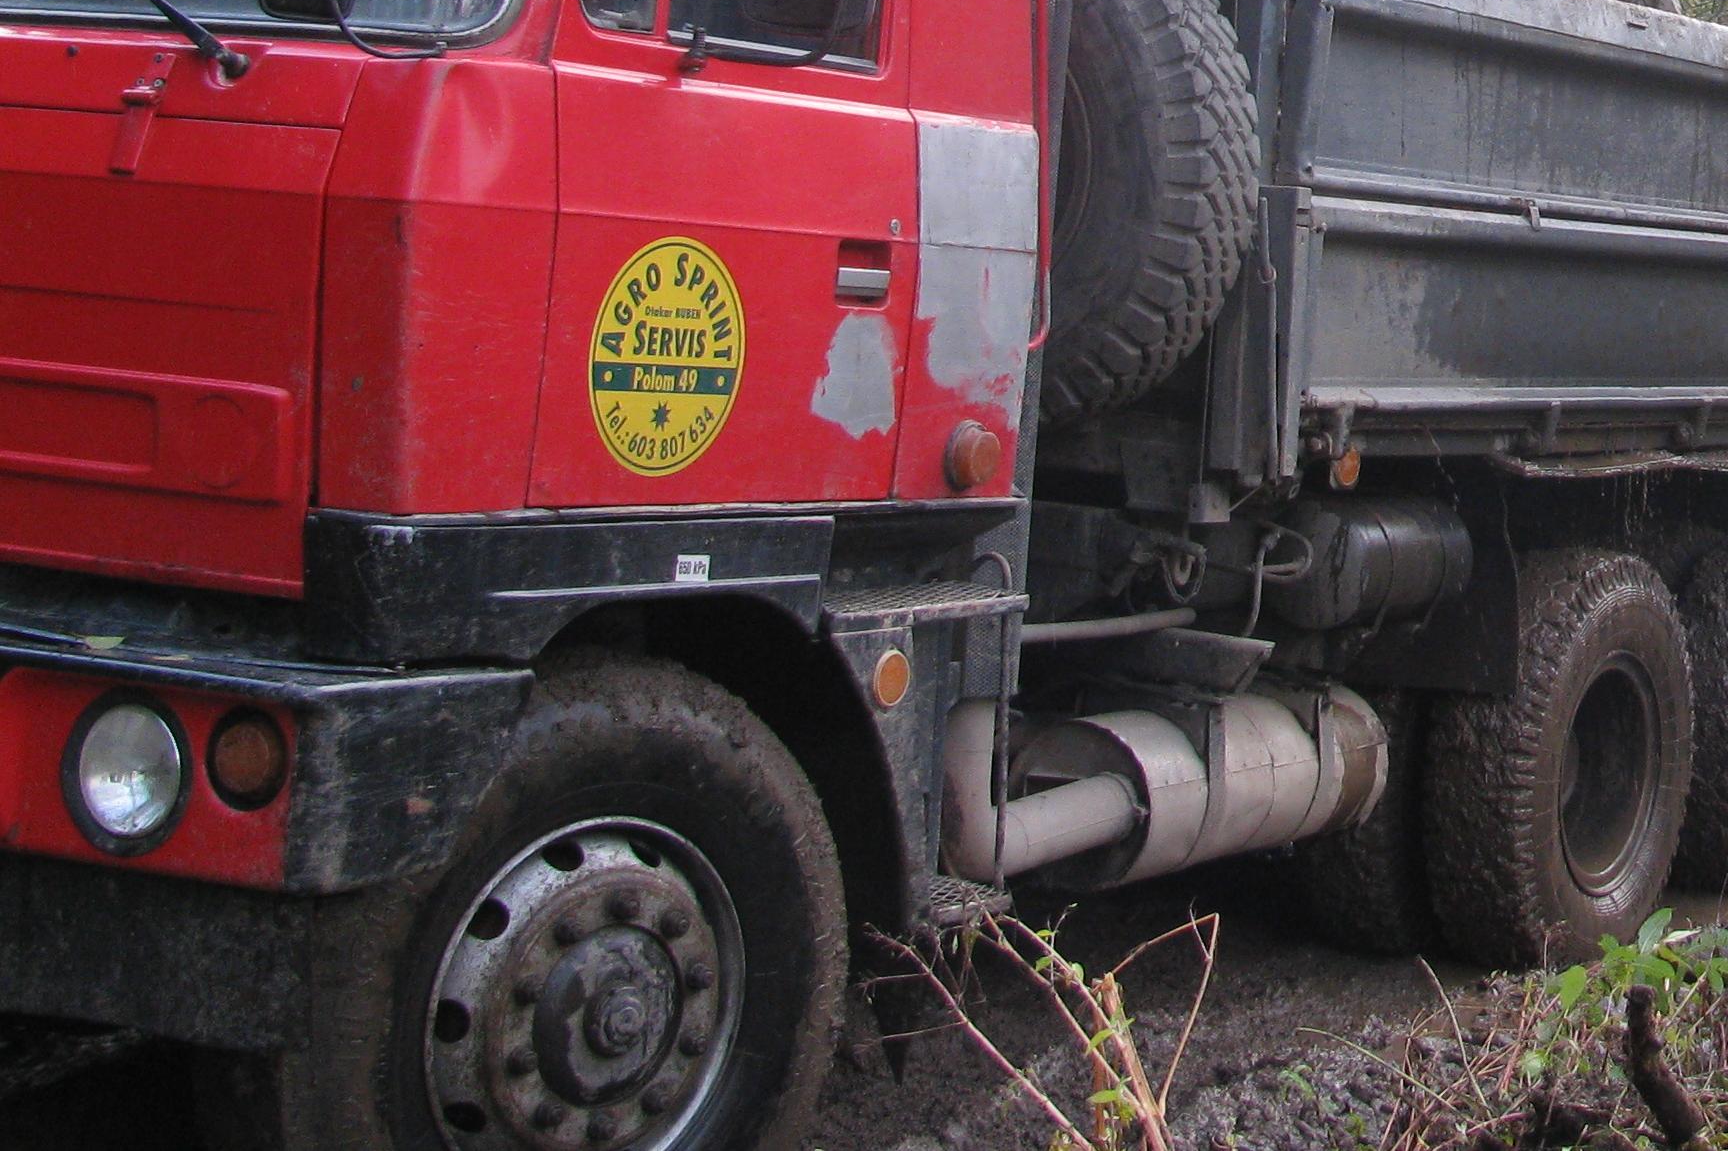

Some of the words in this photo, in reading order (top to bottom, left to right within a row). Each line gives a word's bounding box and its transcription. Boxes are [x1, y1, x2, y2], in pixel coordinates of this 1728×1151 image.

[601, 262, 661, 358] AGRO
[674, 253, 733, 361] SPRINT
[633, 320, 706, 358] SERVIS
[633, 367, 675, 391] Polom
[679, 369, 698, 392] 49
[606, 401, 629, 444] Tel.:
[628, 431, 655, 460] 603
[660, 430, 686, 460] 807
[689, 406, 715, 444] 634
